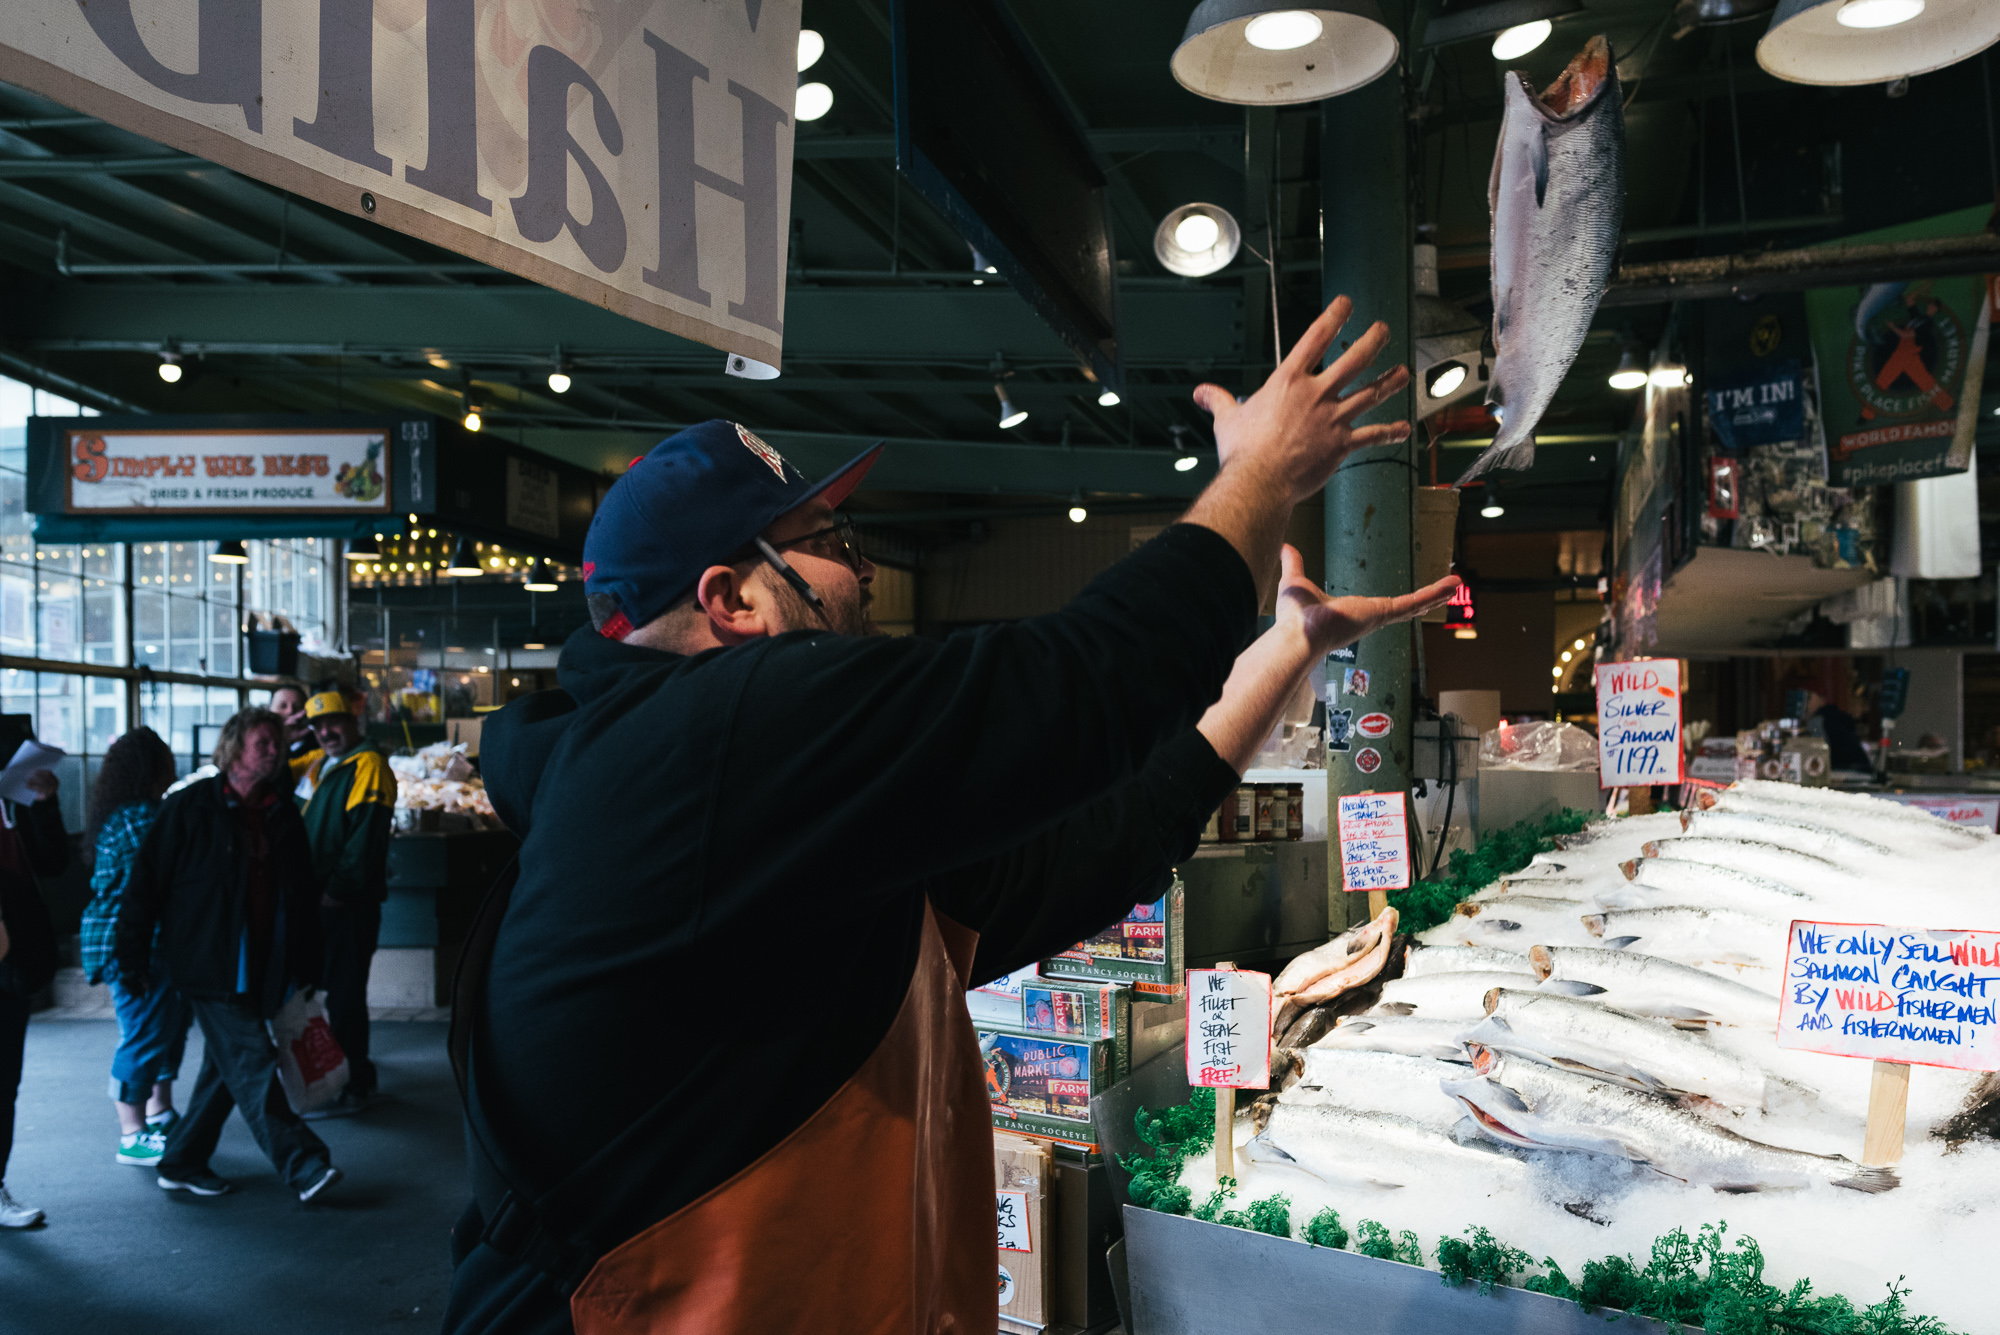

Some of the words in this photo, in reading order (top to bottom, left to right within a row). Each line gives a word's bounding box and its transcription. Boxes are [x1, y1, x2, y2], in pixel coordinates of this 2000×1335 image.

[1852, 345, 1867, 383] PIKE
[1860, 383, 1900, 412] PLACE
[1937, 316, 1960, 384] MARKET
[1716, 387, 1755, 412] I'M
[1760, 379, 1795, 405] IN!
[1842, 427, 1901, 448] WORLD
[1902, 419, 1956, 439] FAMO
[72, 434, 197, 483] SIMPLY
[203, 455, 255, 477] THE
[262, 454, 330, 477] BEST
[1842, 453, 1944, 480] #pikeplacef
[150, 486, 191, 500] DRIED
[206, 486, 249, 500] FRESH
[252, 486, 315, 500] PRODUCE
[1611, 669, 1659, 695] WILD
[1604, 694, 1670, 719] SILVER
[1604, 721, 1677, 748] SALMON
[1370, 800, 1387, 808] TO
[1348, 811, 1388, 820] TRAVEL
[1346, 842, 1356, 854] 24
[1356, 840, 1382, 850] HOUR
[1347, 866, 1361, 878] 48
[1362, 865, 1388, 877] HOUR
[1798, 924, 1836, 954] WE
[1836, 930, 1895, 965] ONLY
[1896, 934, 1955, 963] SELL
[1047, 963, 1076, 973] EXTRA
[1081, 966, 1113, 977] FANCY
[1117, 970, 1162, 982] SOCKEYE
[1791, 957, 1880, 984] SALMON
[1891, 964, 2000, 999] CAUGHT
[1136, 984, 1168, 994] ALMON
[1208, 973, 1228, 992] WE
[1199, 994, 1248, 1012] FILLET
[1794, 982, 1829, 1015] BY
[1894, 990, 1996, 1026] FISHERMEN
[1200, 1020, 1241, 1038] STEAK
[1797, 1013, 1833, 1031] AND
[1024, 1044, 1066, 1062] PUBLIC
[1203, 1038, 1238, 1056] FISH
[1002, 1064, 1010, 1092] MARKET
[1014, 1062, 1059, 1078] MARKET
[1199, 1064, 1241, 1085] FREE!
[1005, 1120, 1036, 1132] FANCY
[1042, 1126, 1088, 1140] SOCKEYE
